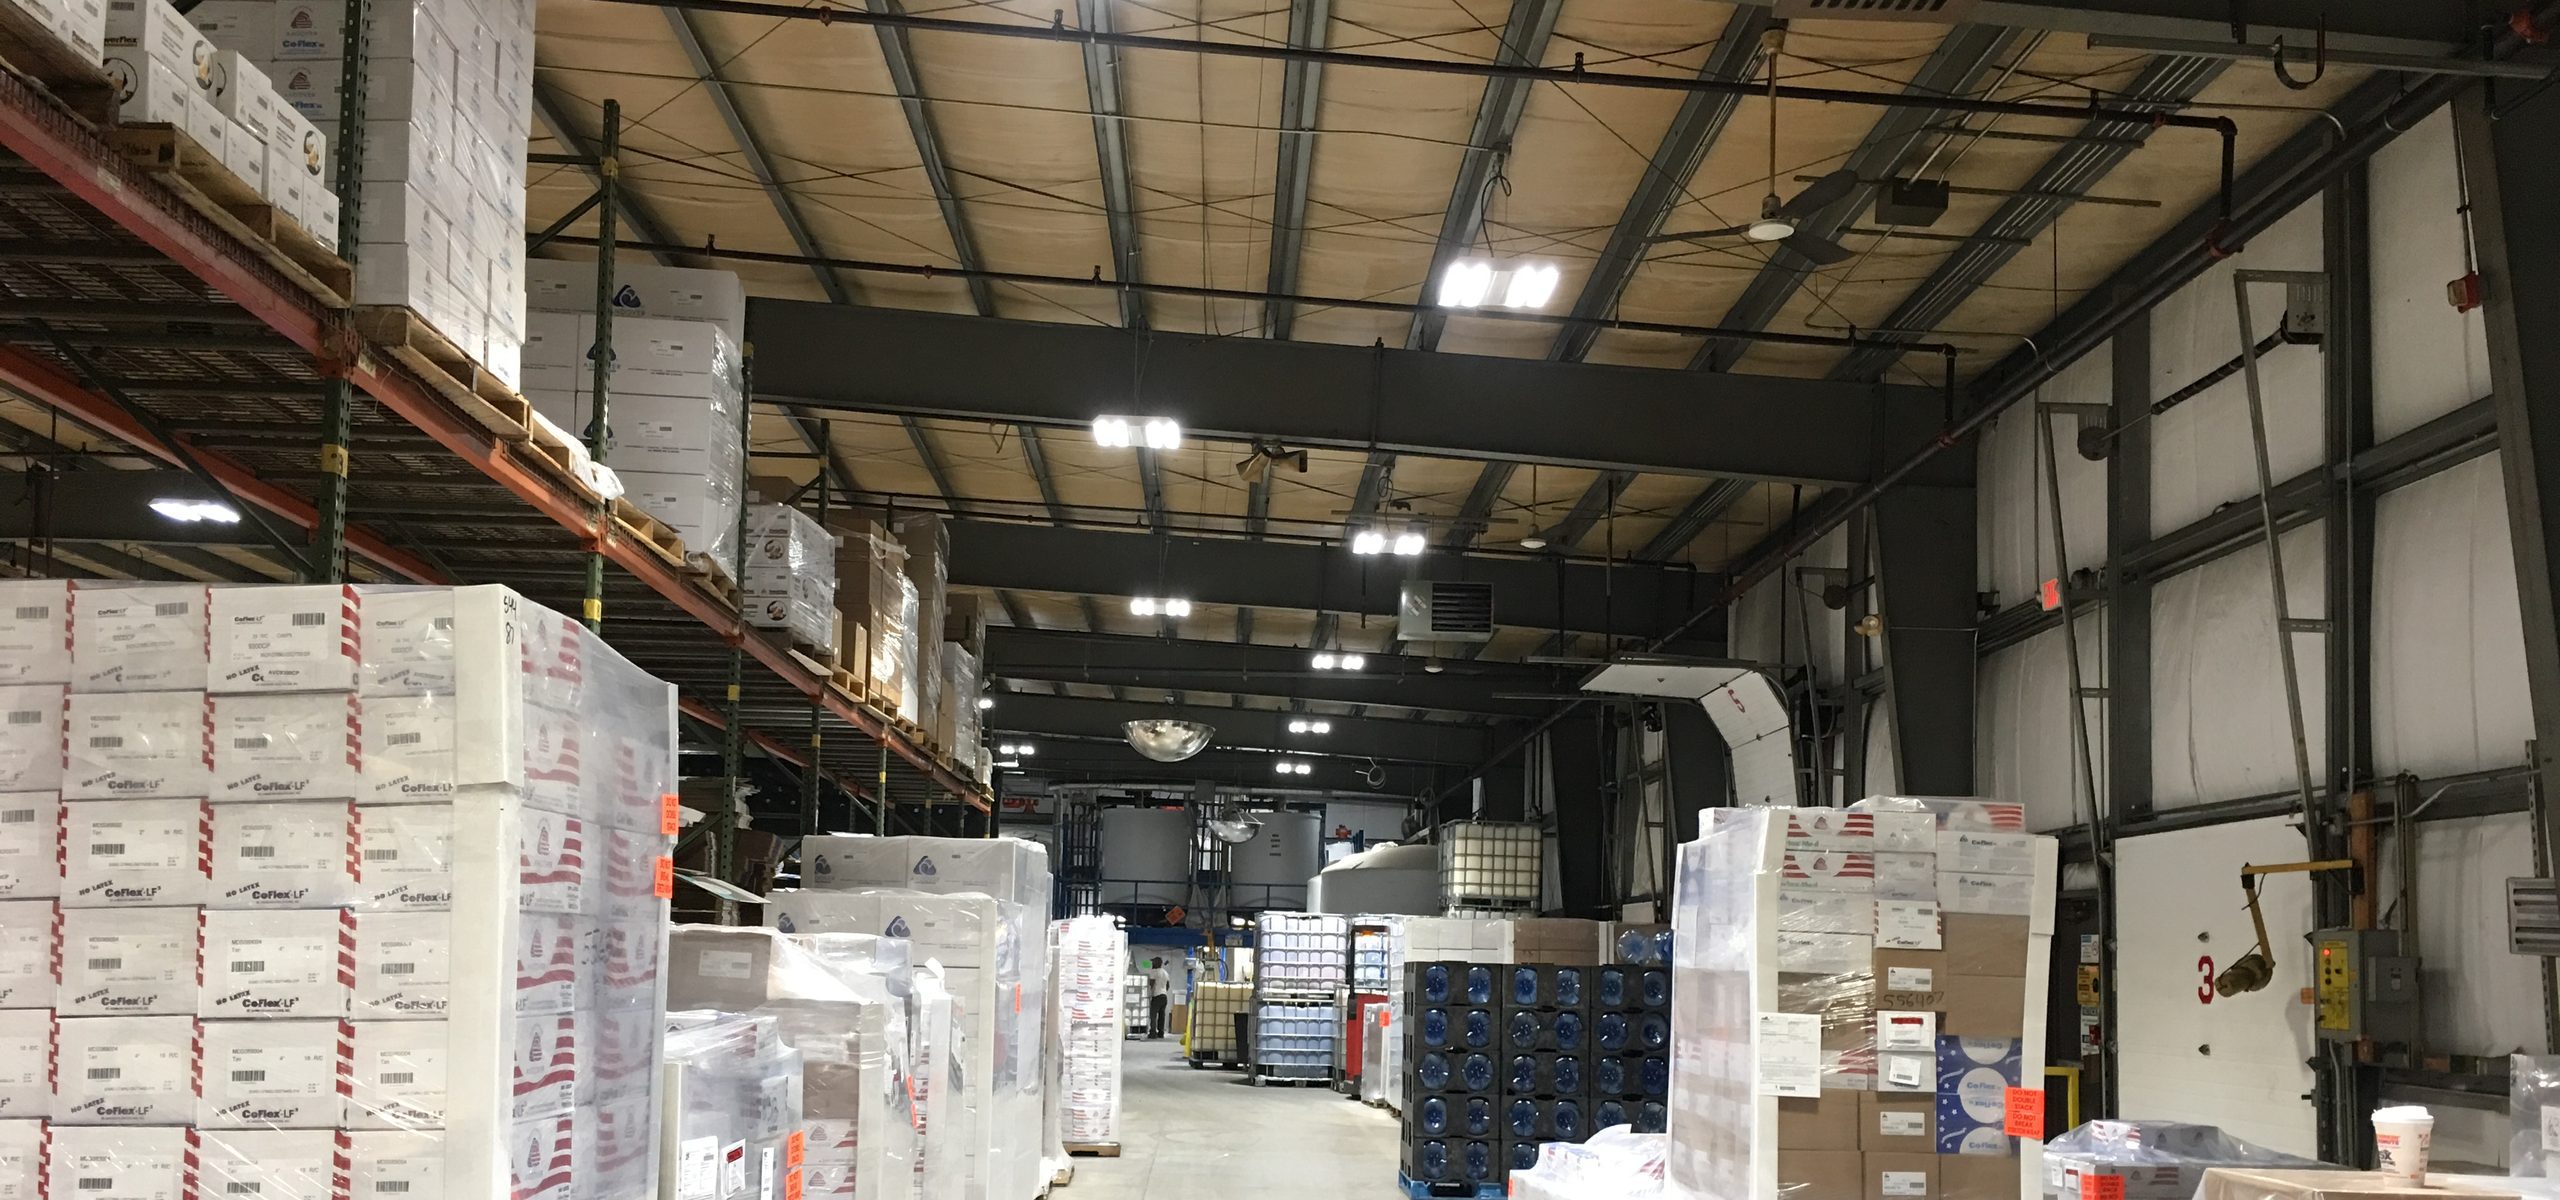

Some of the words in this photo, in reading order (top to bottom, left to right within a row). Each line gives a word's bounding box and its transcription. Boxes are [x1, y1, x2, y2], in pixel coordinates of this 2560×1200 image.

[239, 665, 260, 676] LATEX
[79, 888, 90, 896] NO
[226, 890, 237, 898] NO
[239, 882, 260, 893] LATEX
[2198, 955, 2214, 1004] 3
[1883, 991, 1944, 1008] 556407
[70, 1105, 82, 1113] NO
